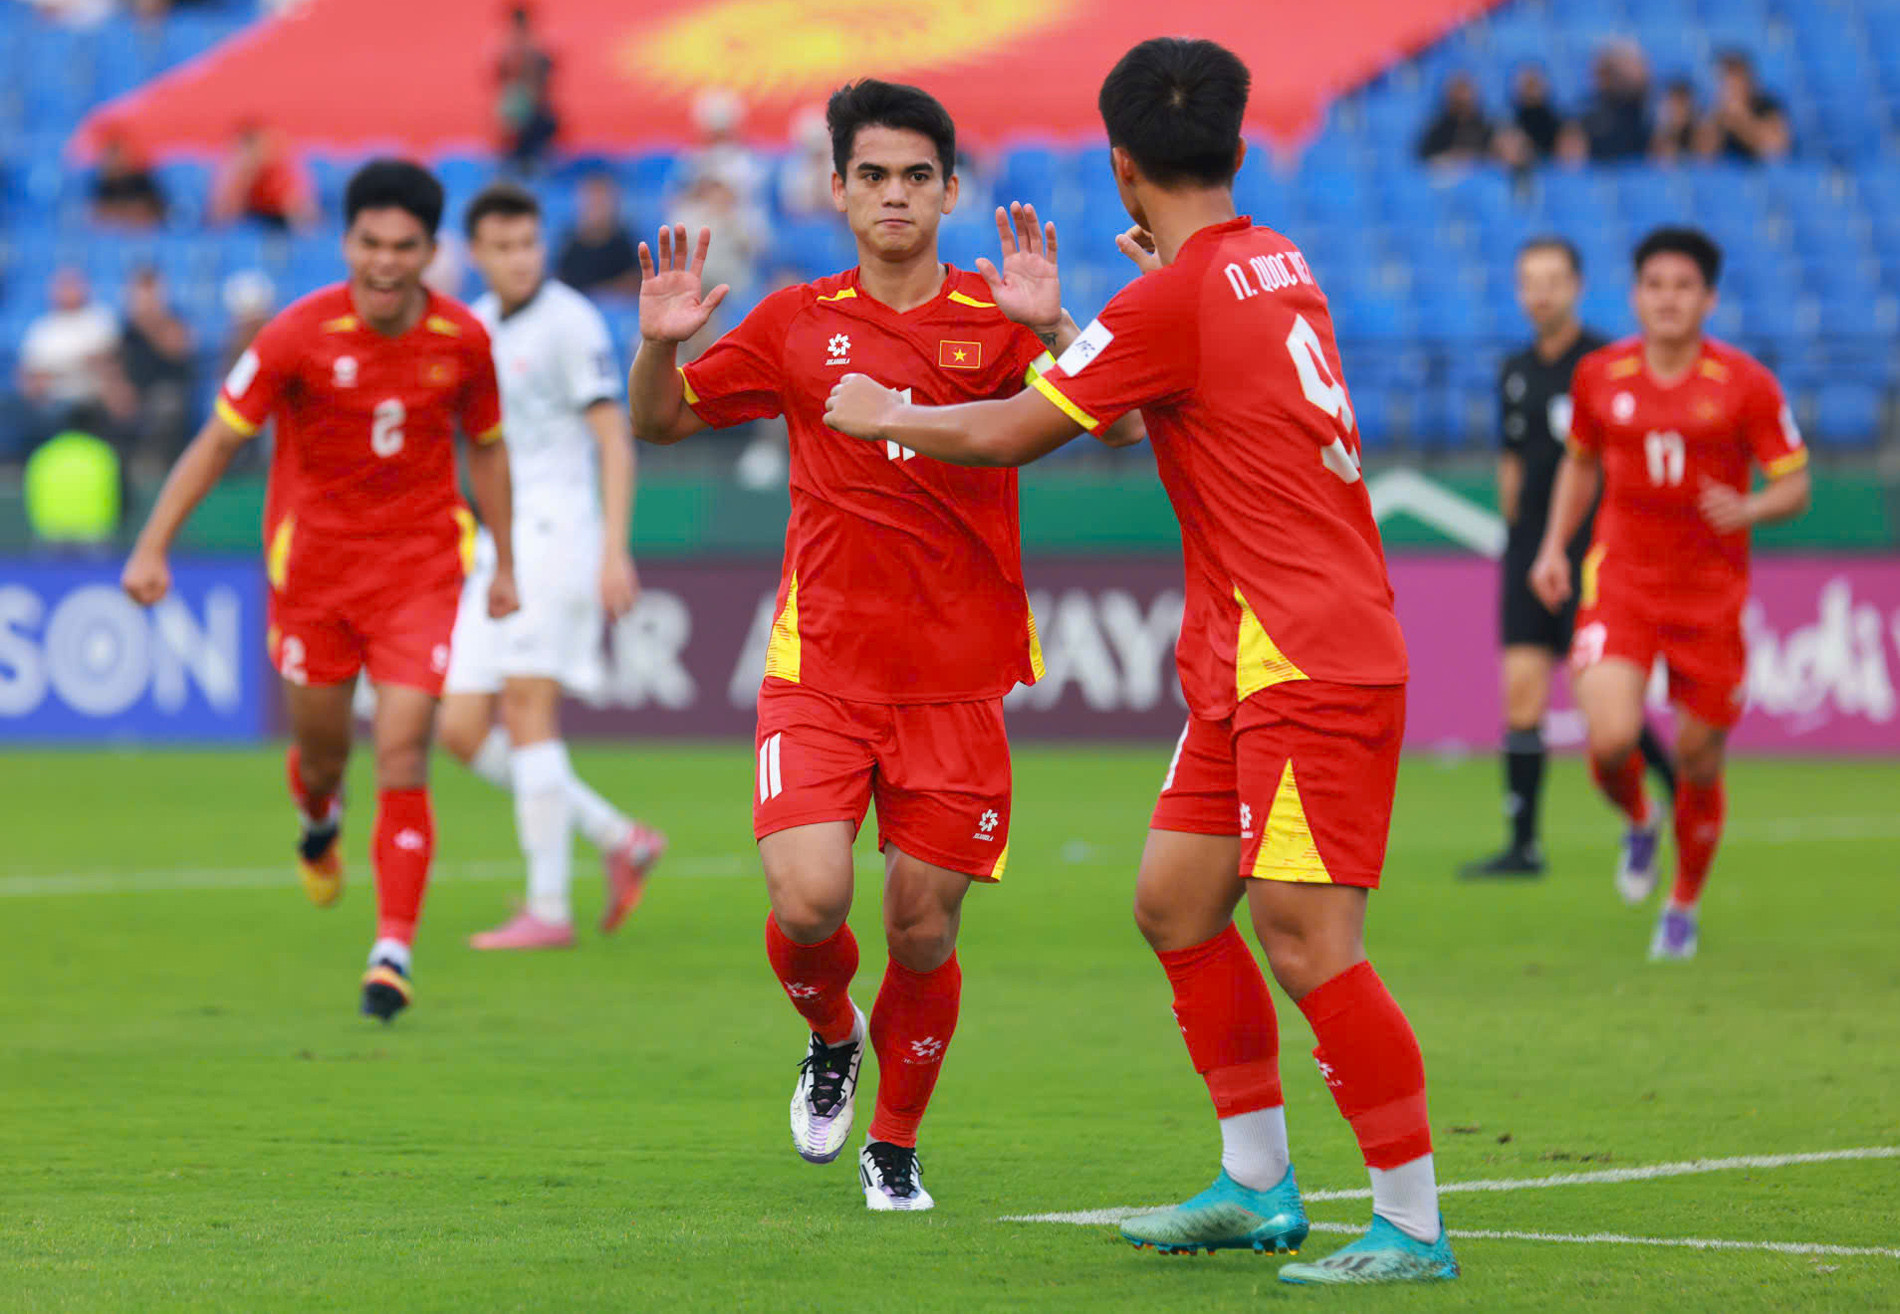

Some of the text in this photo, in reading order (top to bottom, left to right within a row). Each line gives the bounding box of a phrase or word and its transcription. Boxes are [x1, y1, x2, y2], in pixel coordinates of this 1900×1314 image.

[1249, 252, 1298, 292] QUOC
[371, 397, 406, 459] 2
[1286, 313, 1360, 484] 9
[759, 731, 782, 805] 11
